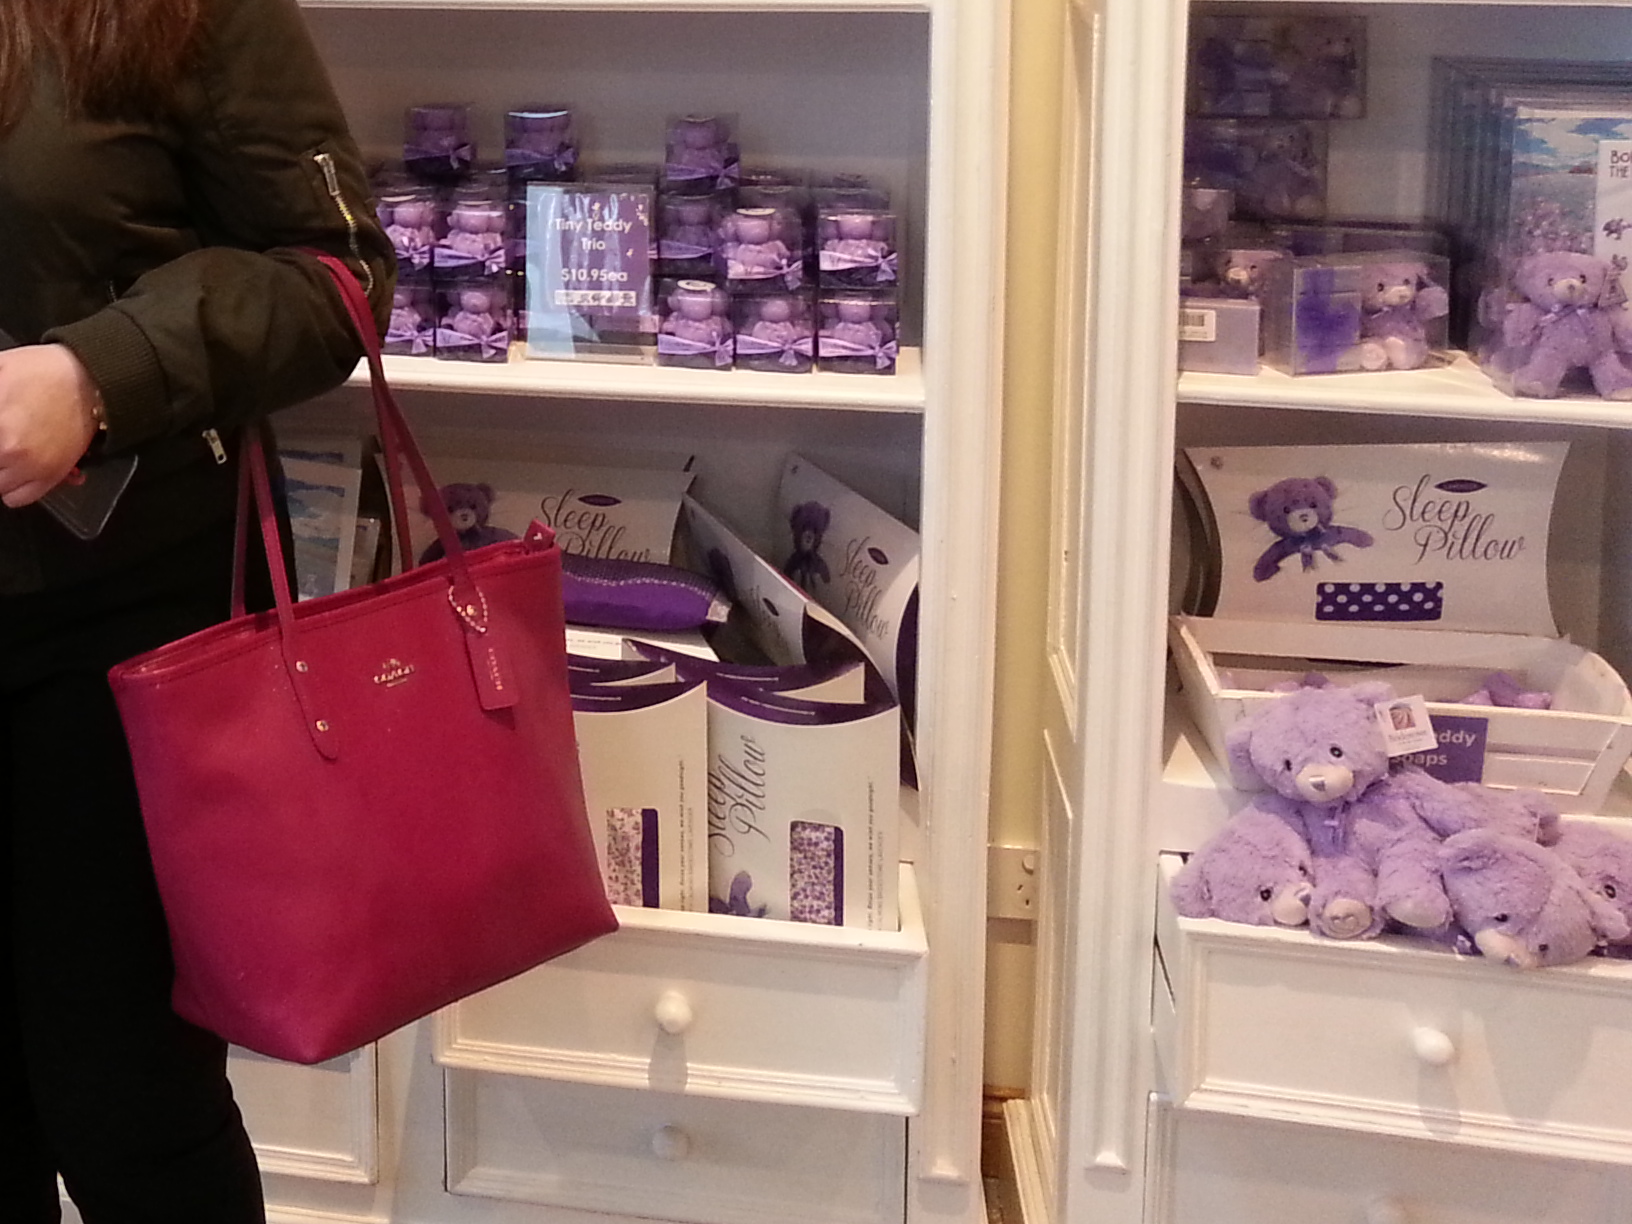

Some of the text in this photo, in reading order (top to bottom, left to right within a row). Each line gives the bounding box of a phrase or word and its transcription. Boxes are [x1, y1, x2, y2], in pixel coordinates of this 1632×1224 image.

[1609, 165, 1630, 178] THE
[555, 218, 633, 234] Tiny Teddy
[581, 237, 606, 251] Trio
[561, 268, 628, 282] $10.95ea
[541, 488, 608, 542] Sleep
[1382, 473, 1474, 532] Sleep
[1414, 513, 1526, 565] Pillow
[718, 734, 771, 843] Pillow
